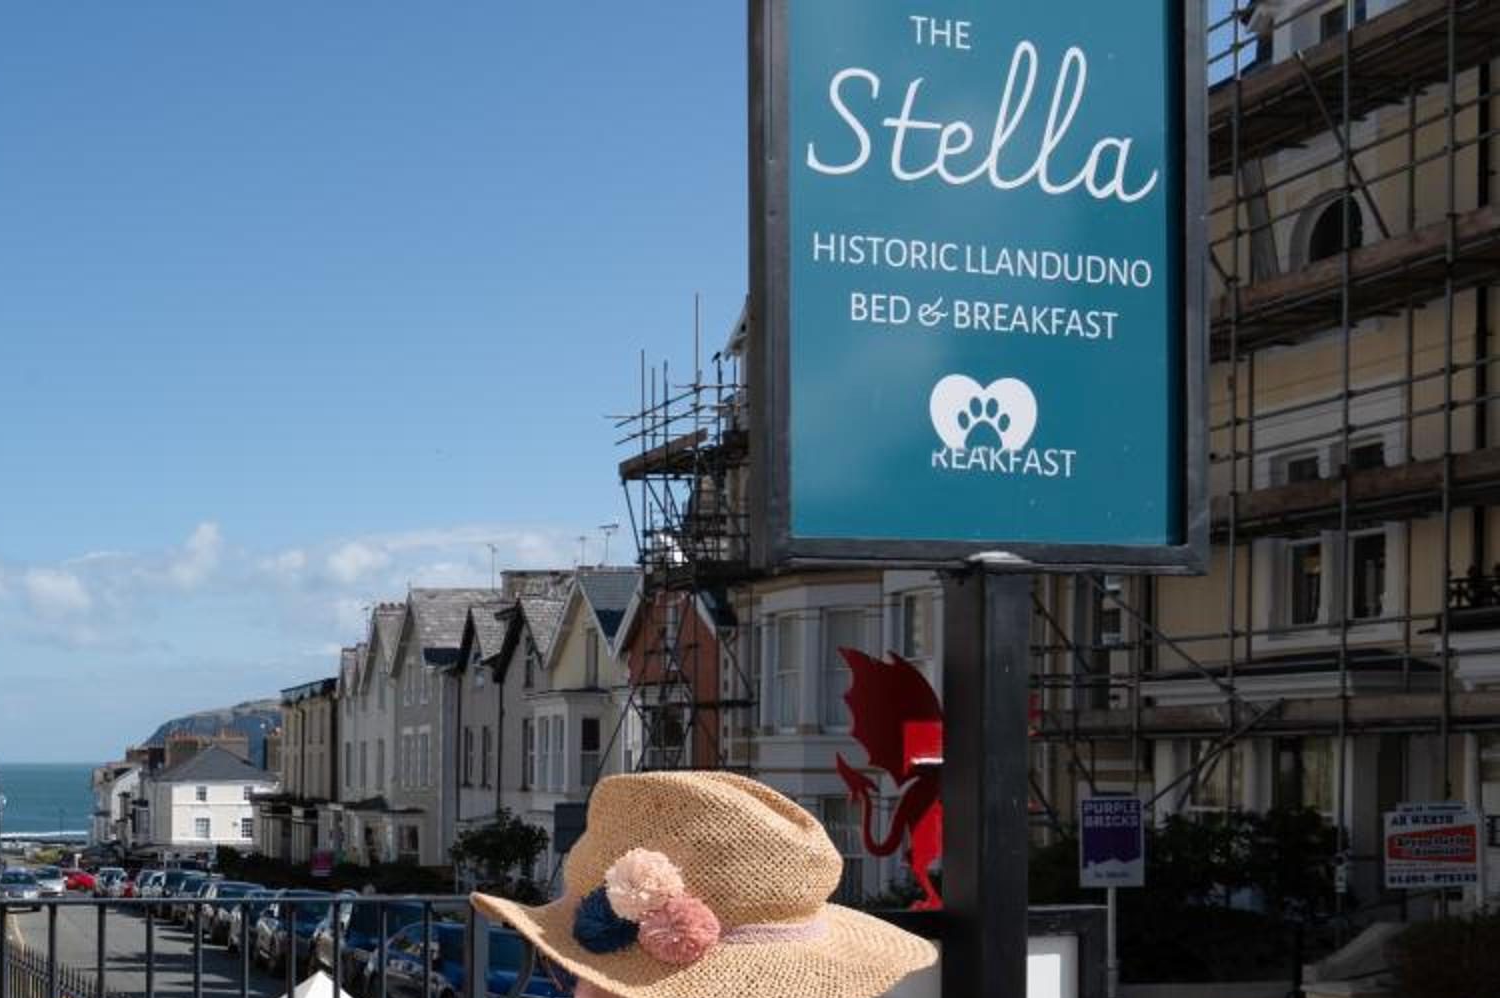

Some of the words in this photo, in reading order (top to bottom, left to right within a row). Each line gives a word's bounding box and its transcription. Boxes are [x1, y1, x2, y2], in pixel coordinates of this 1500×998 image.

[909, 15, 972, 49] THE
[806, 40, 1159, 202] Stella
[812, 232, 958, 272] HISTORIC
[965, 247, 1152, 288] LLANDUDNO
[850, 293, 911, 324] BED
[917, 296, 949, 326] &
[954, 300, 1119, 340] BREAKFAST
[1083, 802, 1139, 814] PURPLE
[1083, 815, 1139, 828] BRICKS
